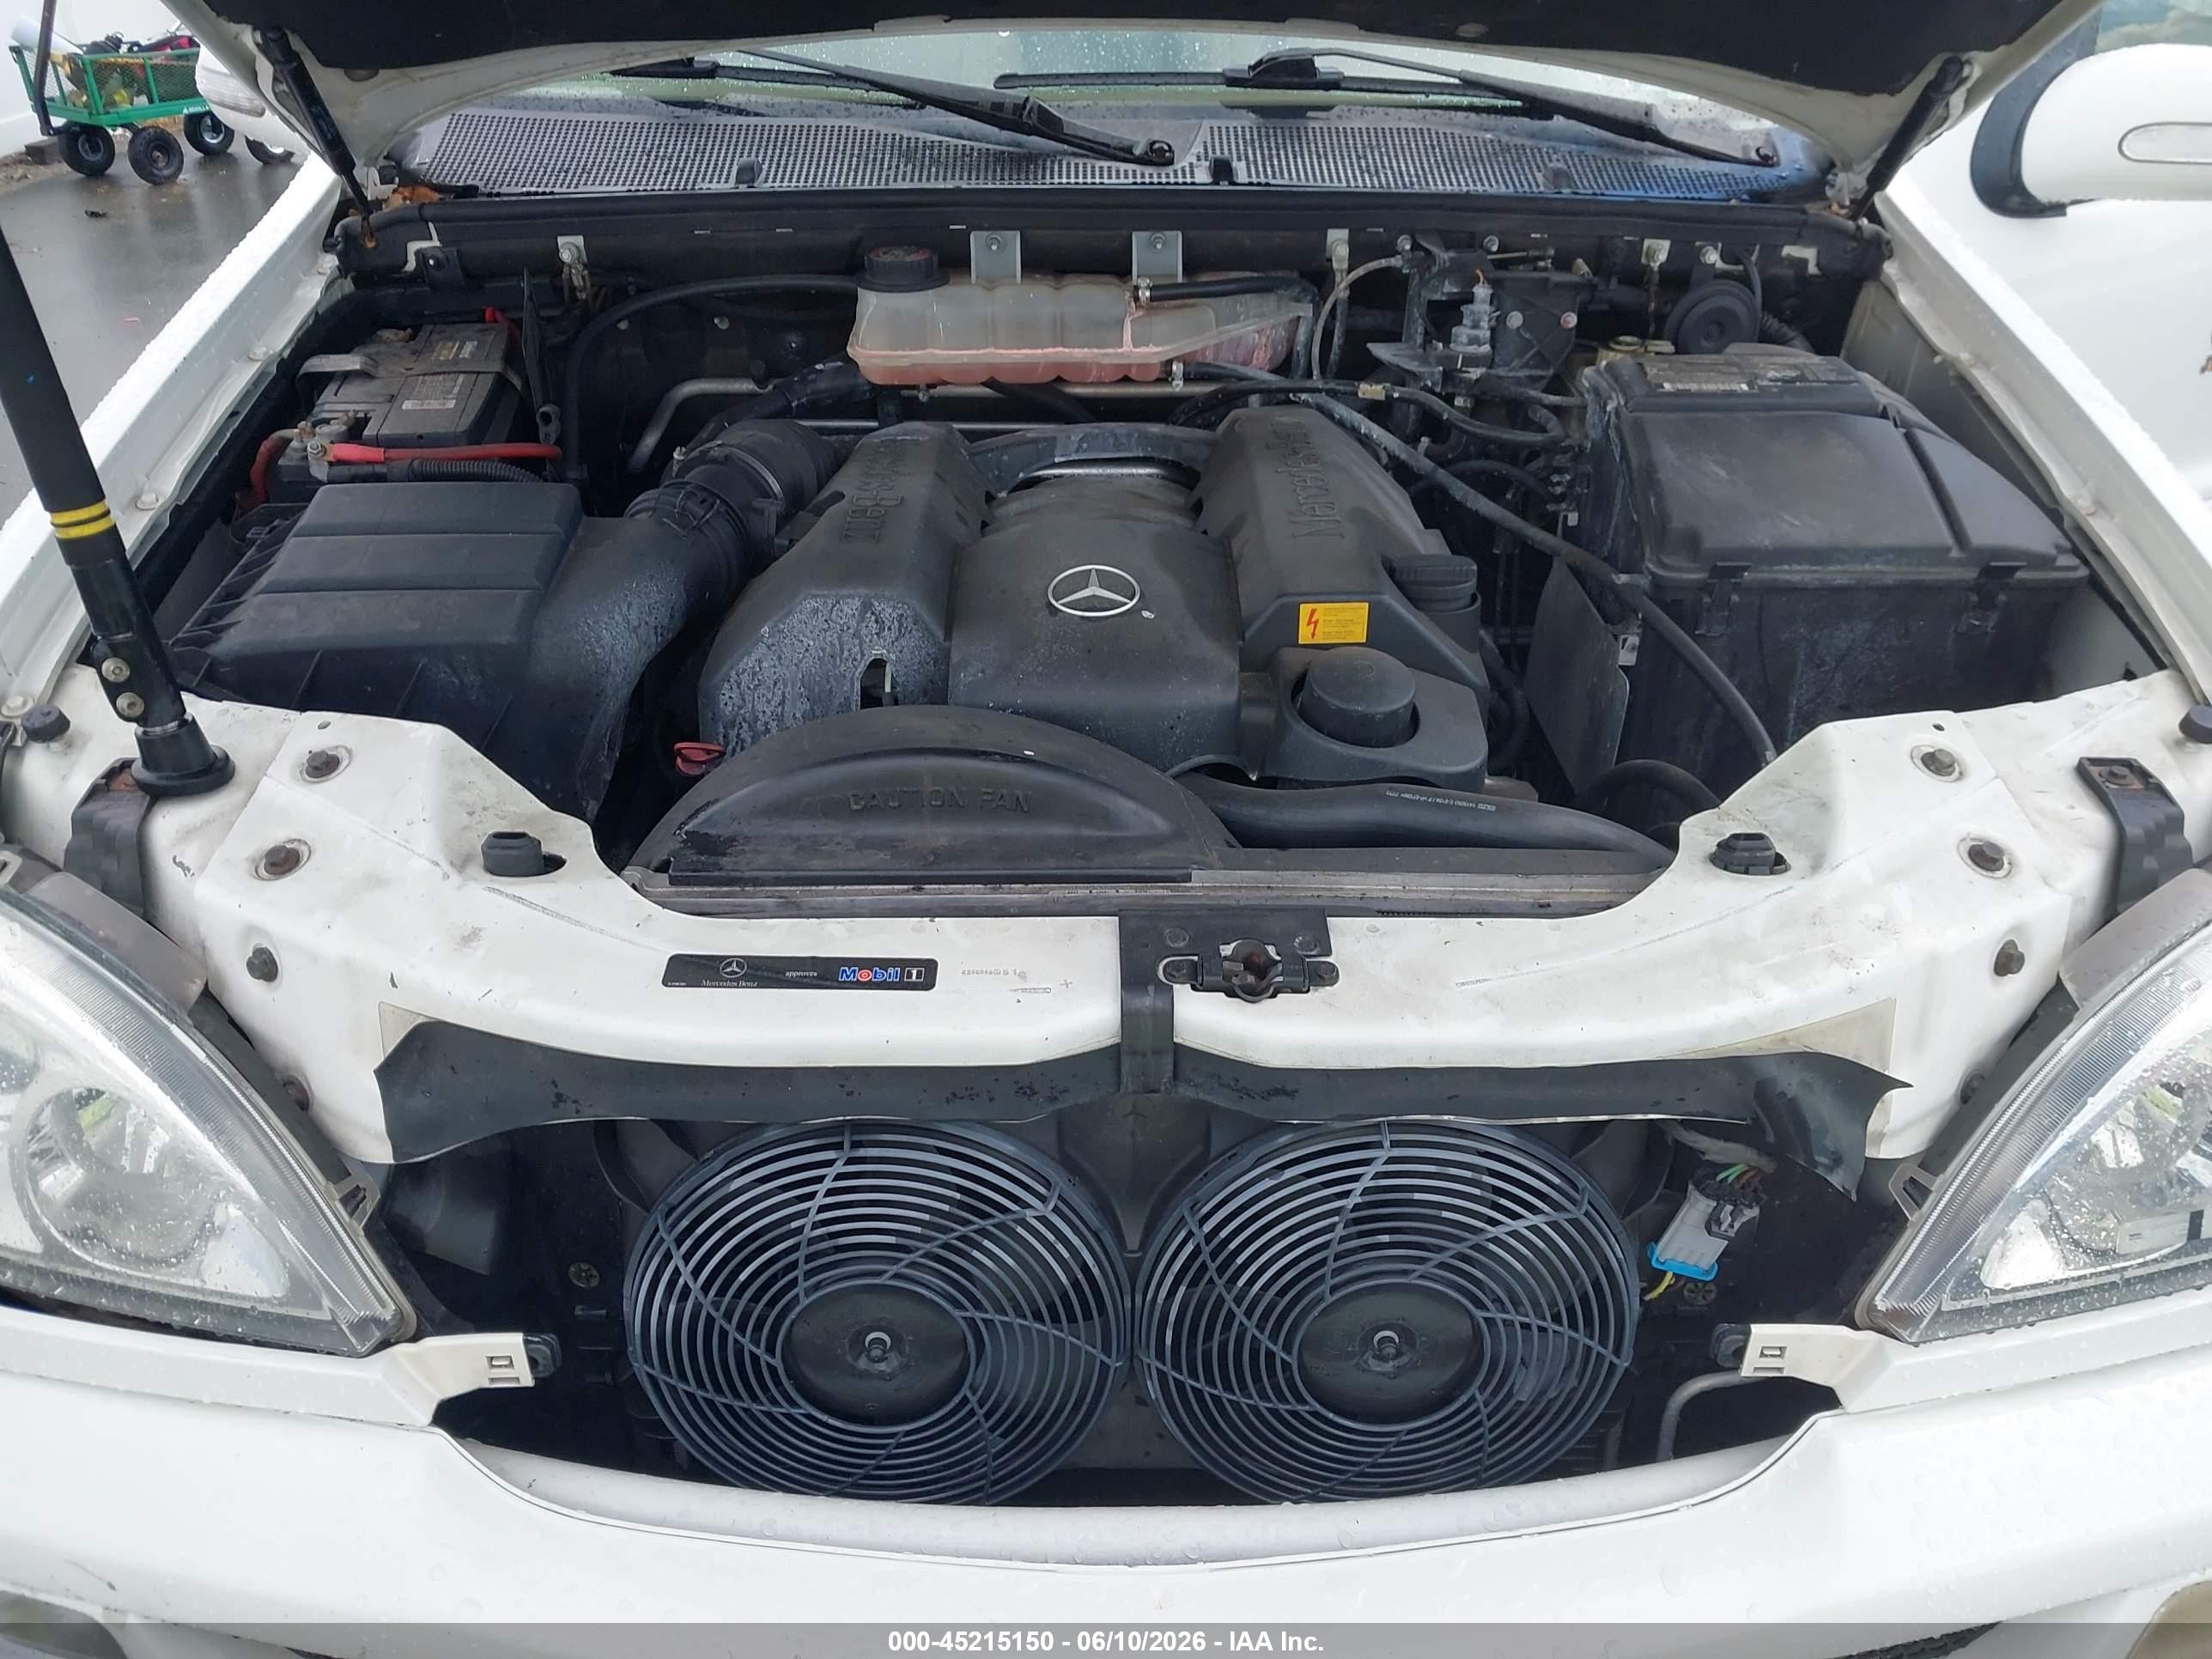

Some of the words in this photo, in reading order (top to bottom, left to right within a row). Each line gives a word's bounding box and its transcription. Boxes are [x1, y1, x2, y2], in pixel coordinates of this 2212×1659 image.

[839, 440, 919, 544] des-Benz
[847, 786, 965, 811] CAUTION
[981, 787, 1032, 812] FAN
[838, 967, 901, 981] Mobil
